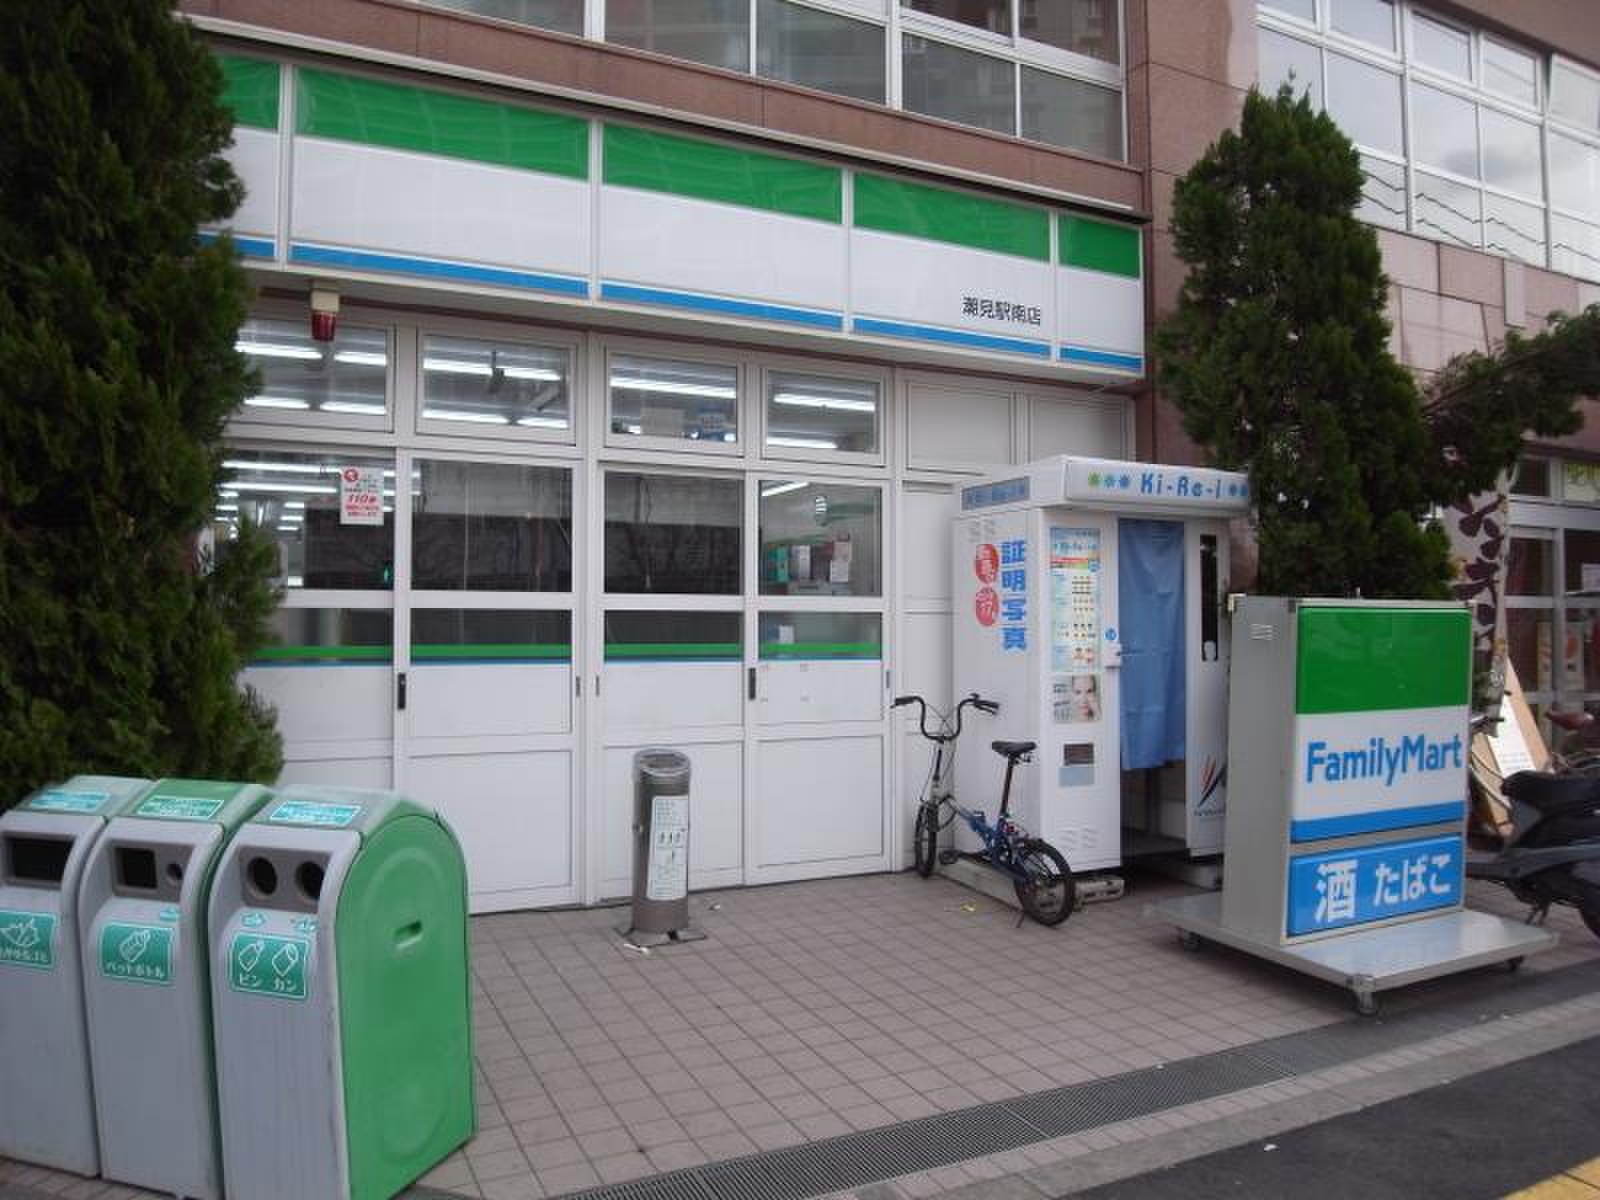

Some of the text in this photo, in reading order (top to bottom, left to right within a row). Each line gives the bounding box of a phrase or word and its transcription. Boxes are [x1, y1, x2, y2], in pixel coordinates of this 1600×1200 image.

[1001, 539, 1026, 651] 証明写真
[1306, 734, 1462, 786] FamilyMart
[1315, 853, 1451, 923] 酒 たばこ
